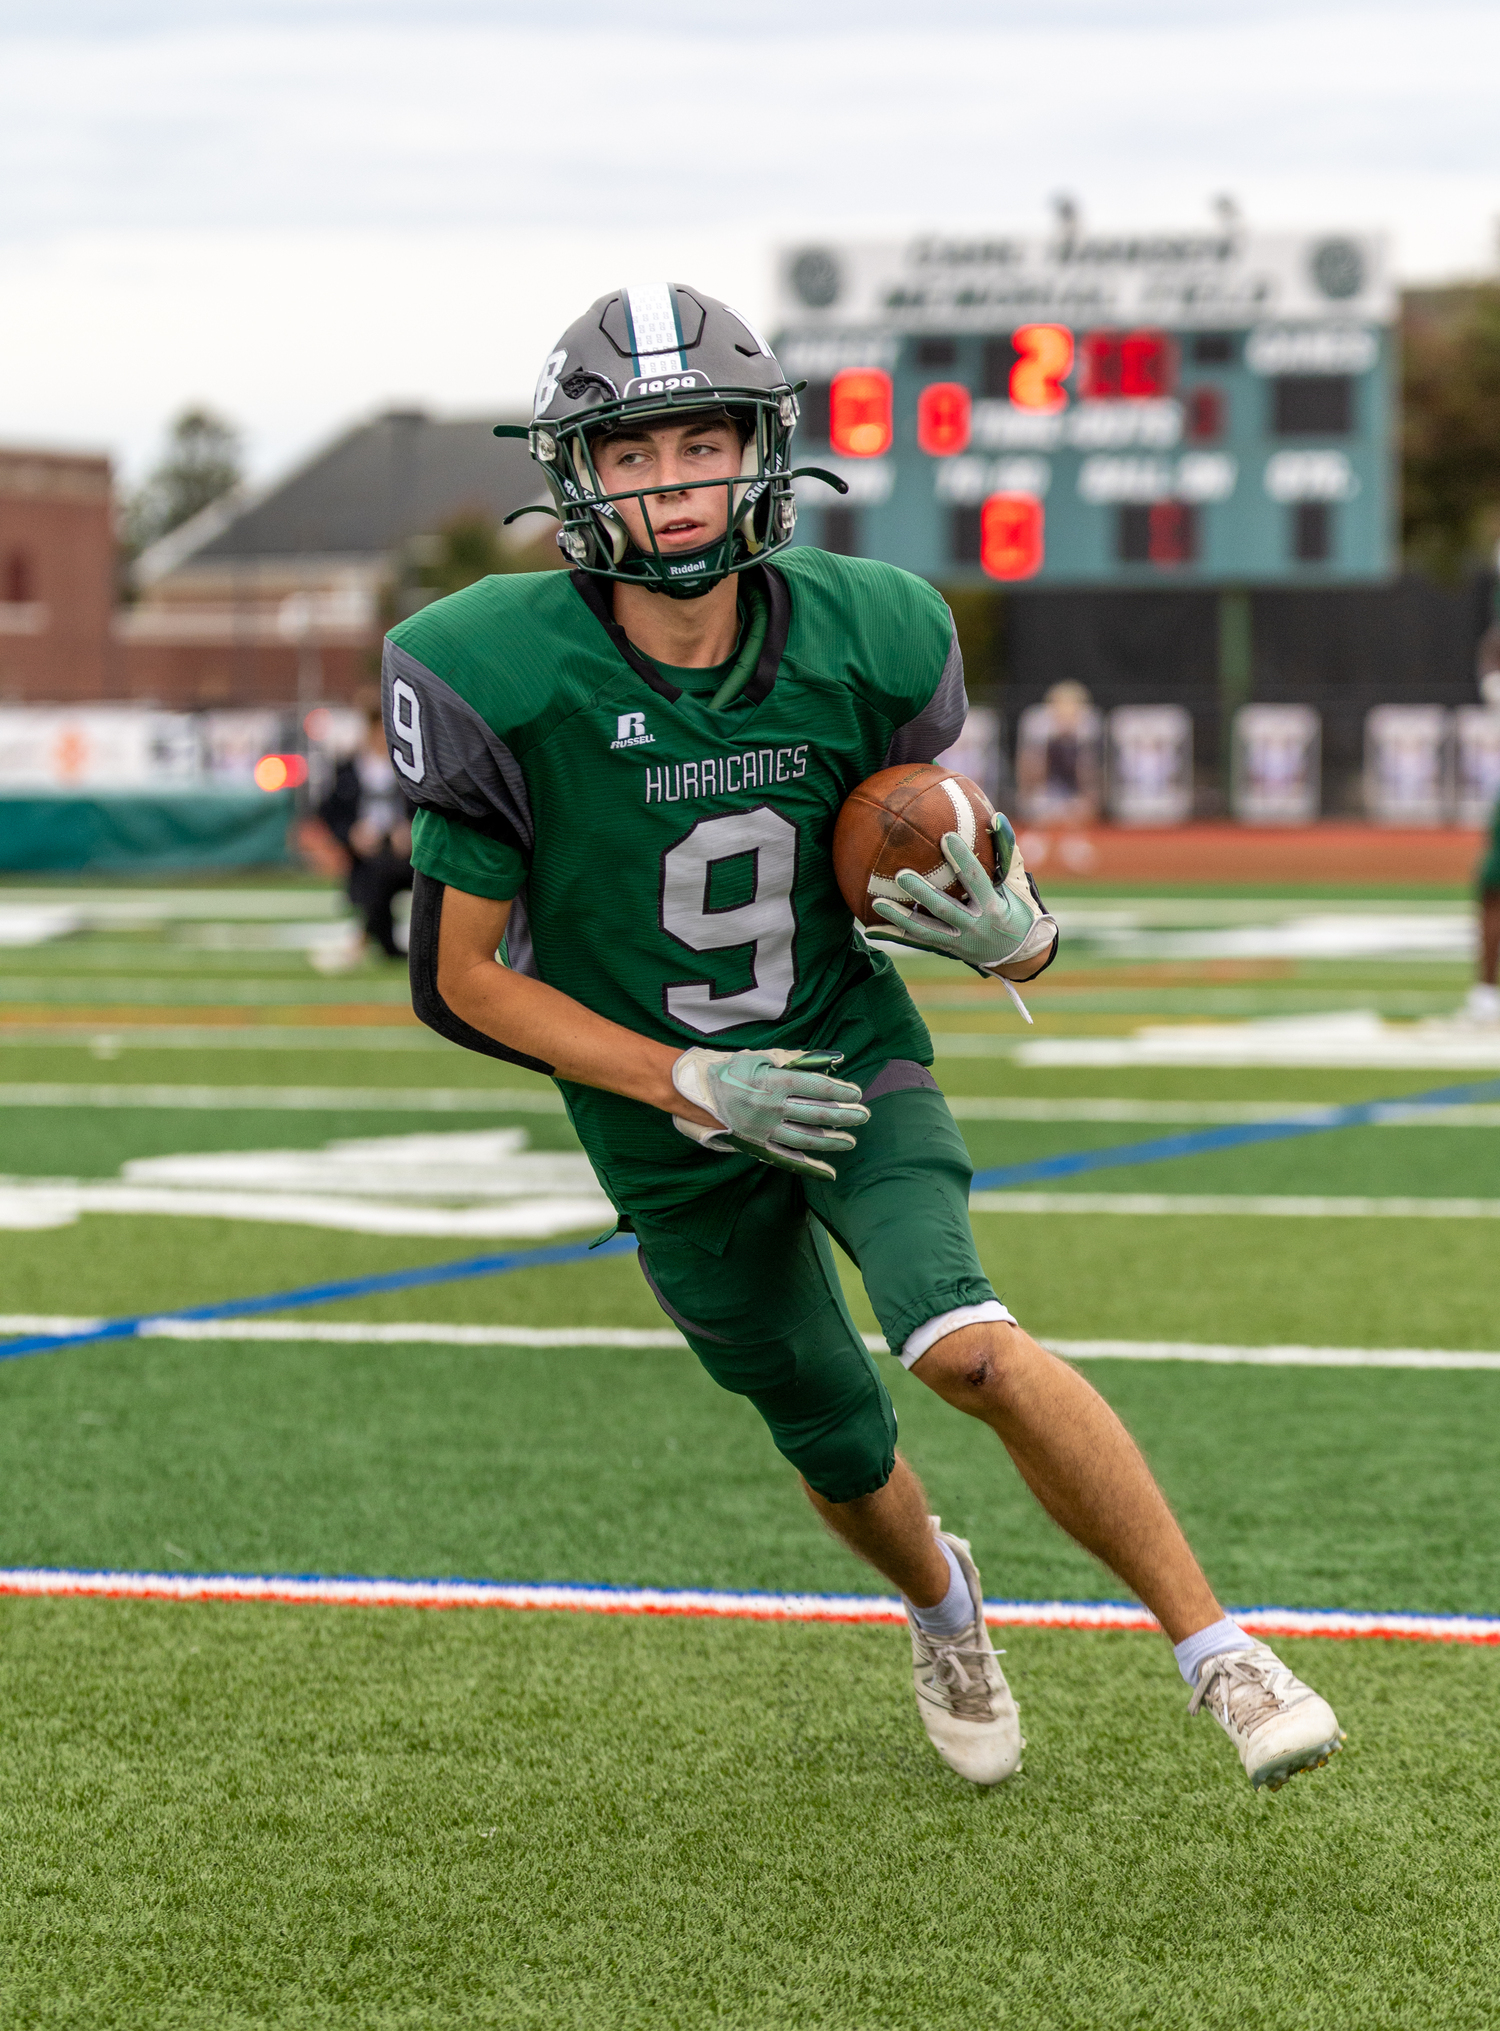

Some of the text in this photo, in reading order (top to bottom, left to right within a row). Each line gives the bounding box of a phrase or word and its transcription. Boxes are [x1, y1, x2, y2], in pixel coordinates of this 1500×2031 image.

[669, 560, 706, 576] Riddell
[392, 676, 426, 786] 9
[609, 733, 656, 750] RUSSELL
[617, 711, 646, 740] R
[645, 744, 809, 804] HURRICANES
[658, 802, 800, 1038] 9
